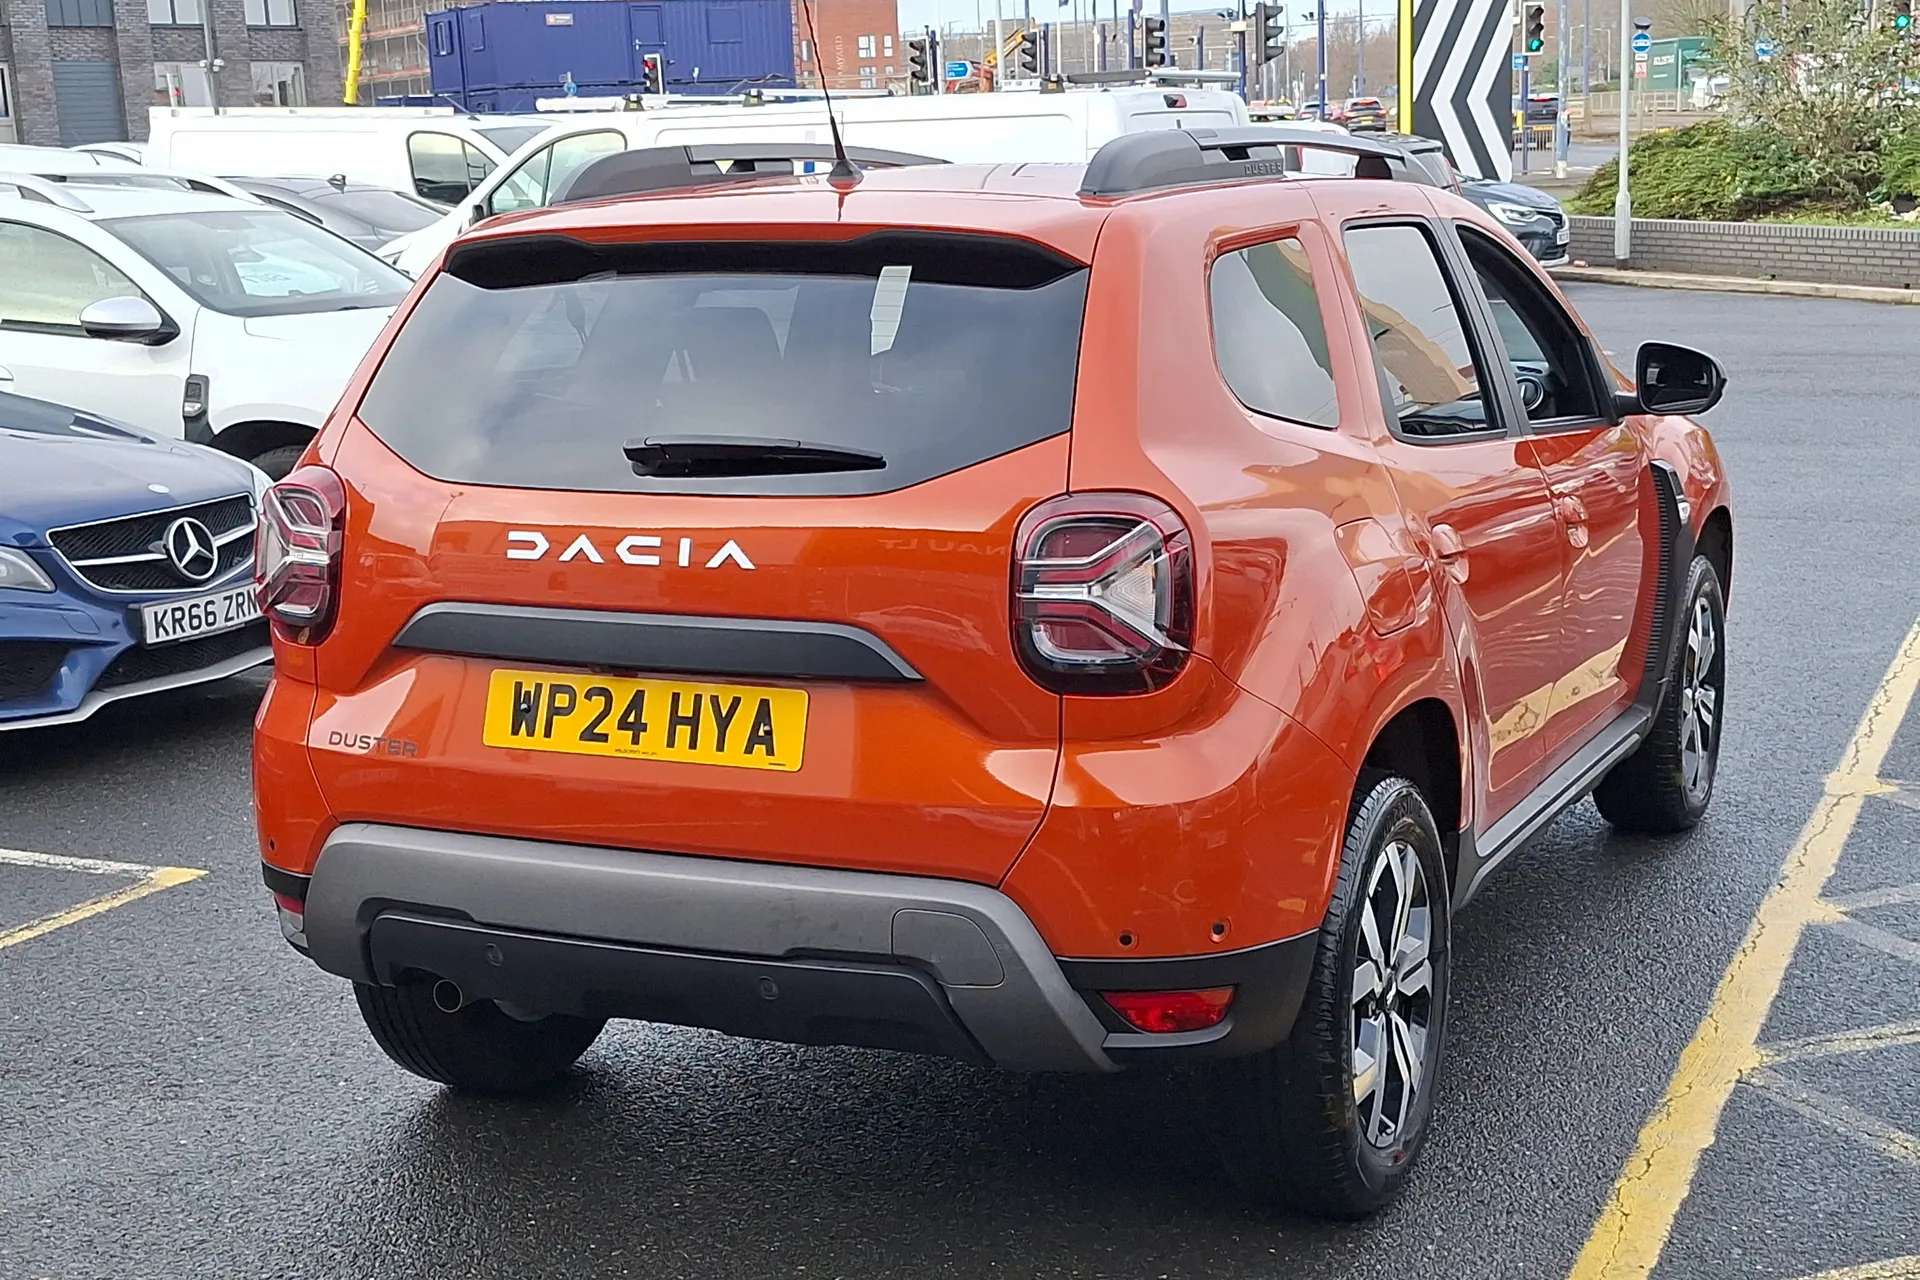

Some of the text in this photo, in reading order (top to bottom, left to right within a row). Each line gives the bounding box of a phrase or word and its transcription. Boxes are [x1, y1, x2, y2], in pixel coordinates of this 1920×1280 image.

[1244, 162, 1283, 177] DUSTER
[506, 530, 757, 570] DACIA
[152, 587, 258, 637] KR66 ZRN
[510, 680, 777, 757] WP24 HYA
[328, 731, 417, 757] DUSTER
